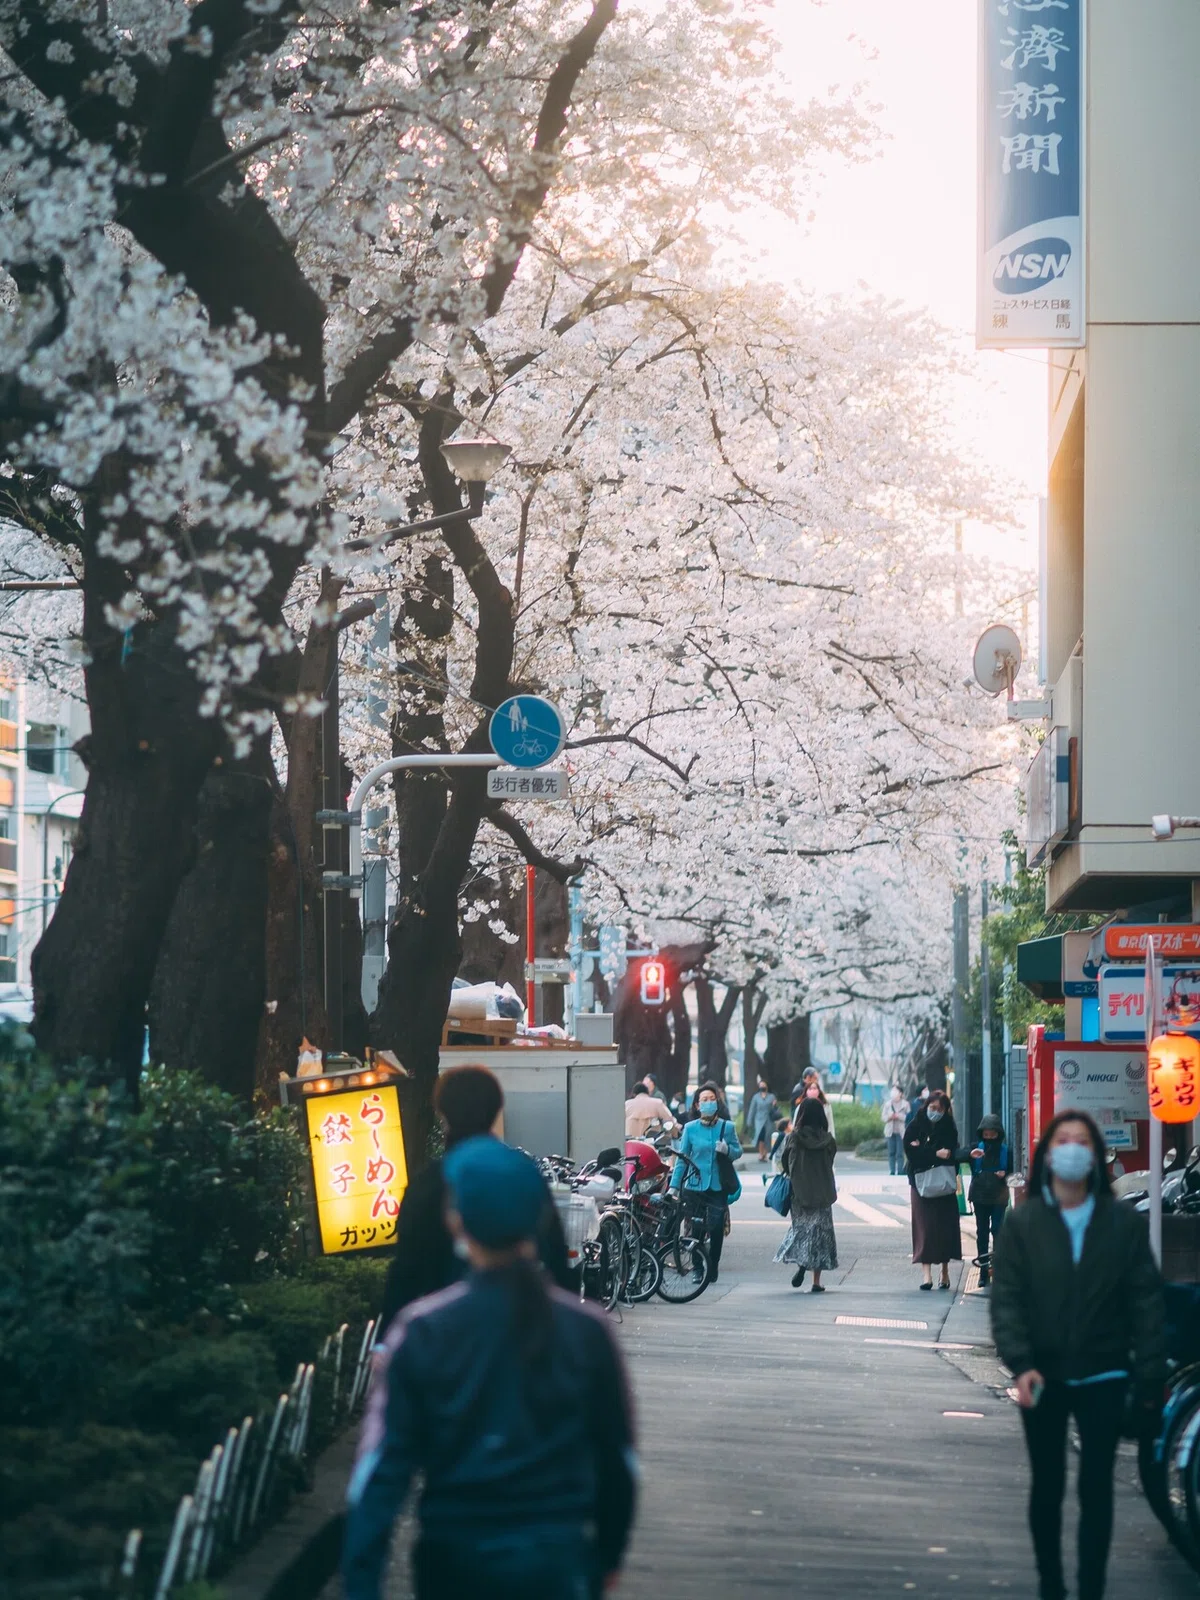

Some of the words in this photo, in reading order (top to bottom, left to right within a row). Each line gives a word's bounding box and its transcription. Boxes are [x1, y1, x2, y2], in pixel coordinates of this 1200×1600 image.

[997, 0, 1070, 175] 濟新聞
[994, 253, 1070, 279] NSN
[993, 299, 1071, 310] ニュースサービス日経
[492, 777, 557, 793] 歩行者優先
[1086, 1074, 1119, 1082] NIKKEI
[322, 1113, 356, 1194] 餃子
[360, 1094, 400, 1218] らーめん
[339, 1221, 398, 1247] ガッツ
